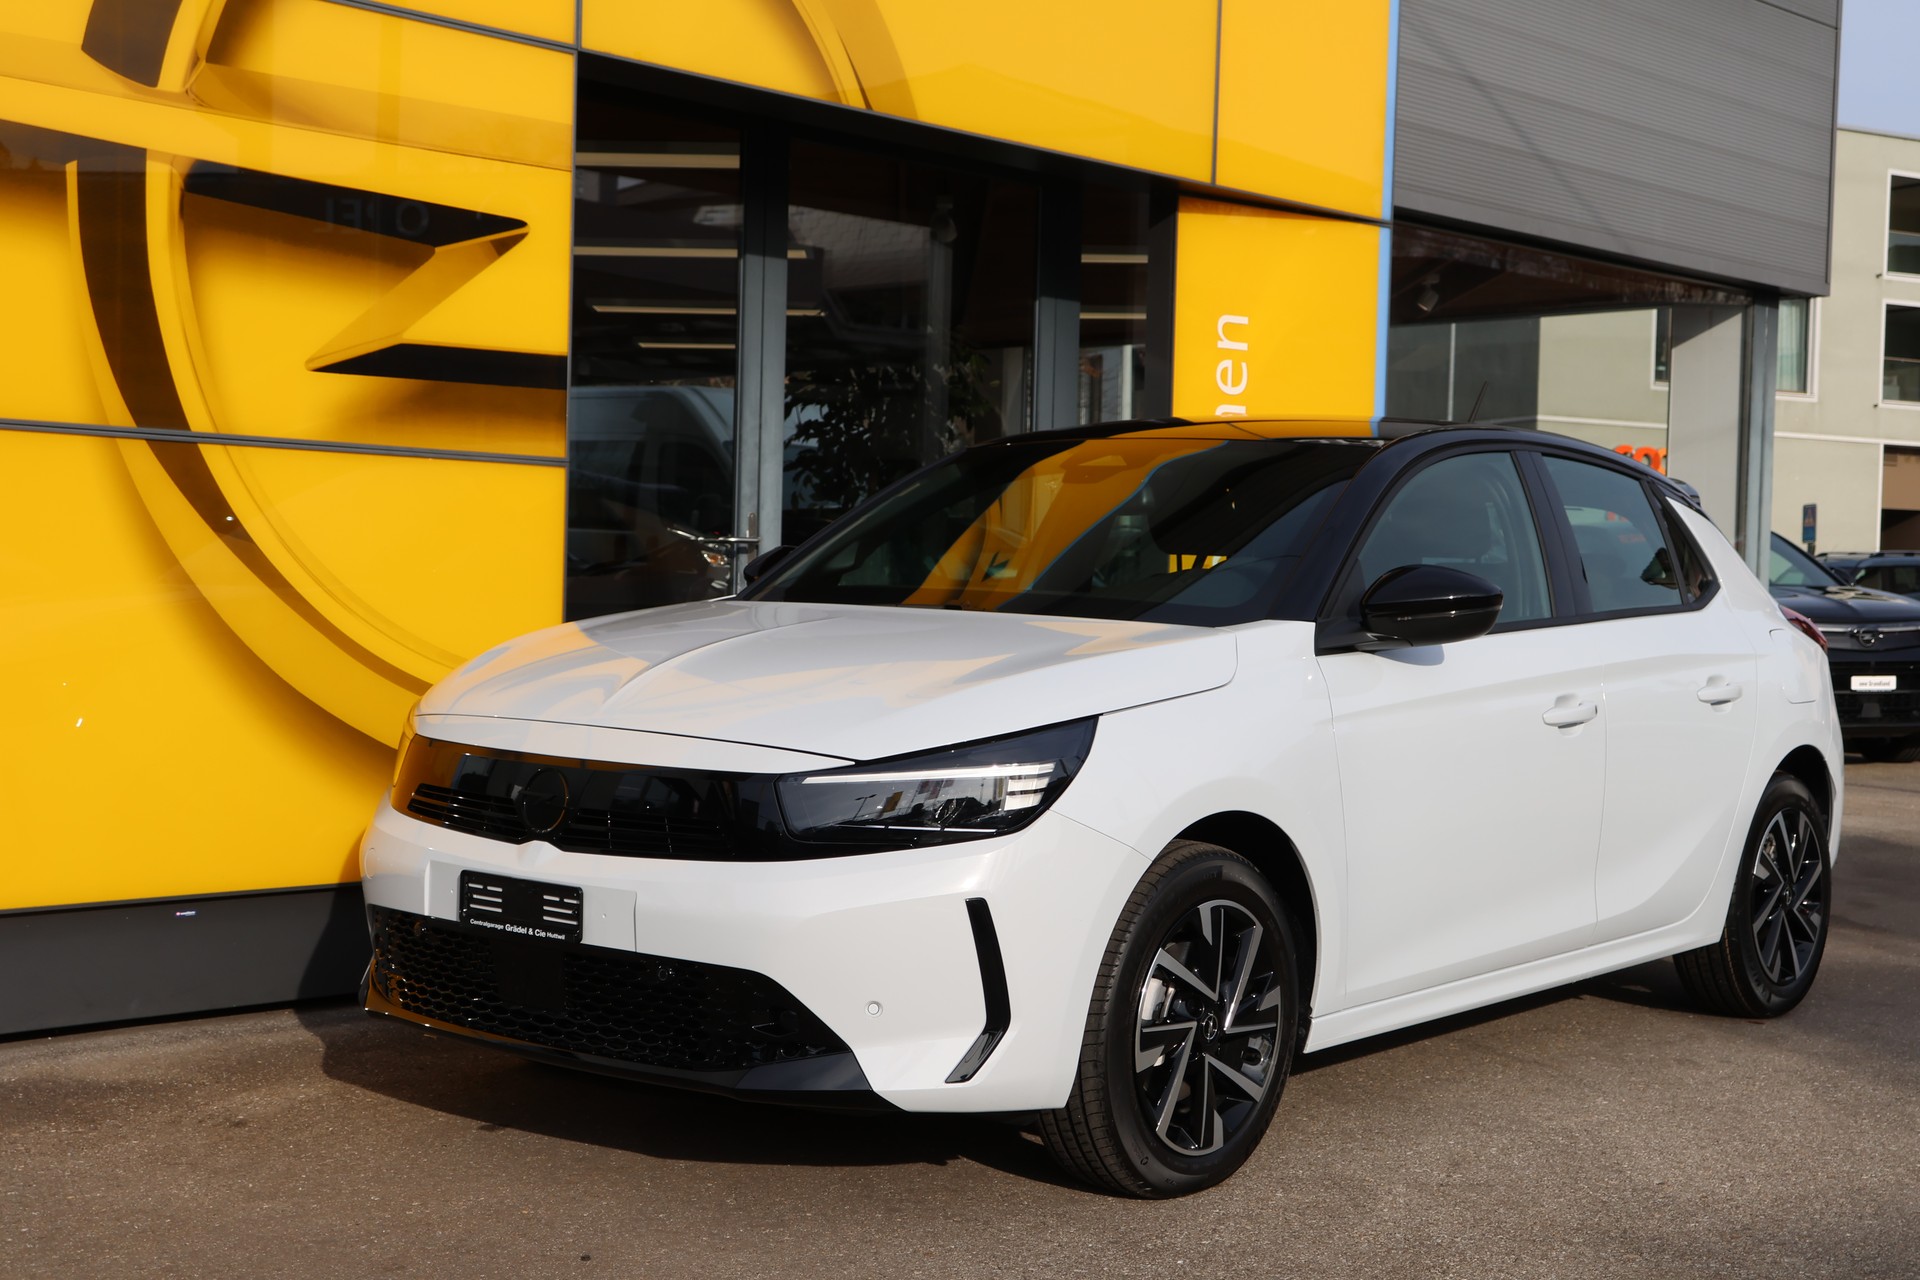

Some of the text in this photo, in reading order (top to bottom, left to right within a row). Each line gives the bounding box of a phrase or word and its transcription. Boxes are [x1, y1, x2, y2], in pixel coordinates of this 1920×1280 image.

[470, 918, 504, 930] Centralgarage
[505, 924, 527, 934] Grädel
[534, 929, 546, 937] Cie
